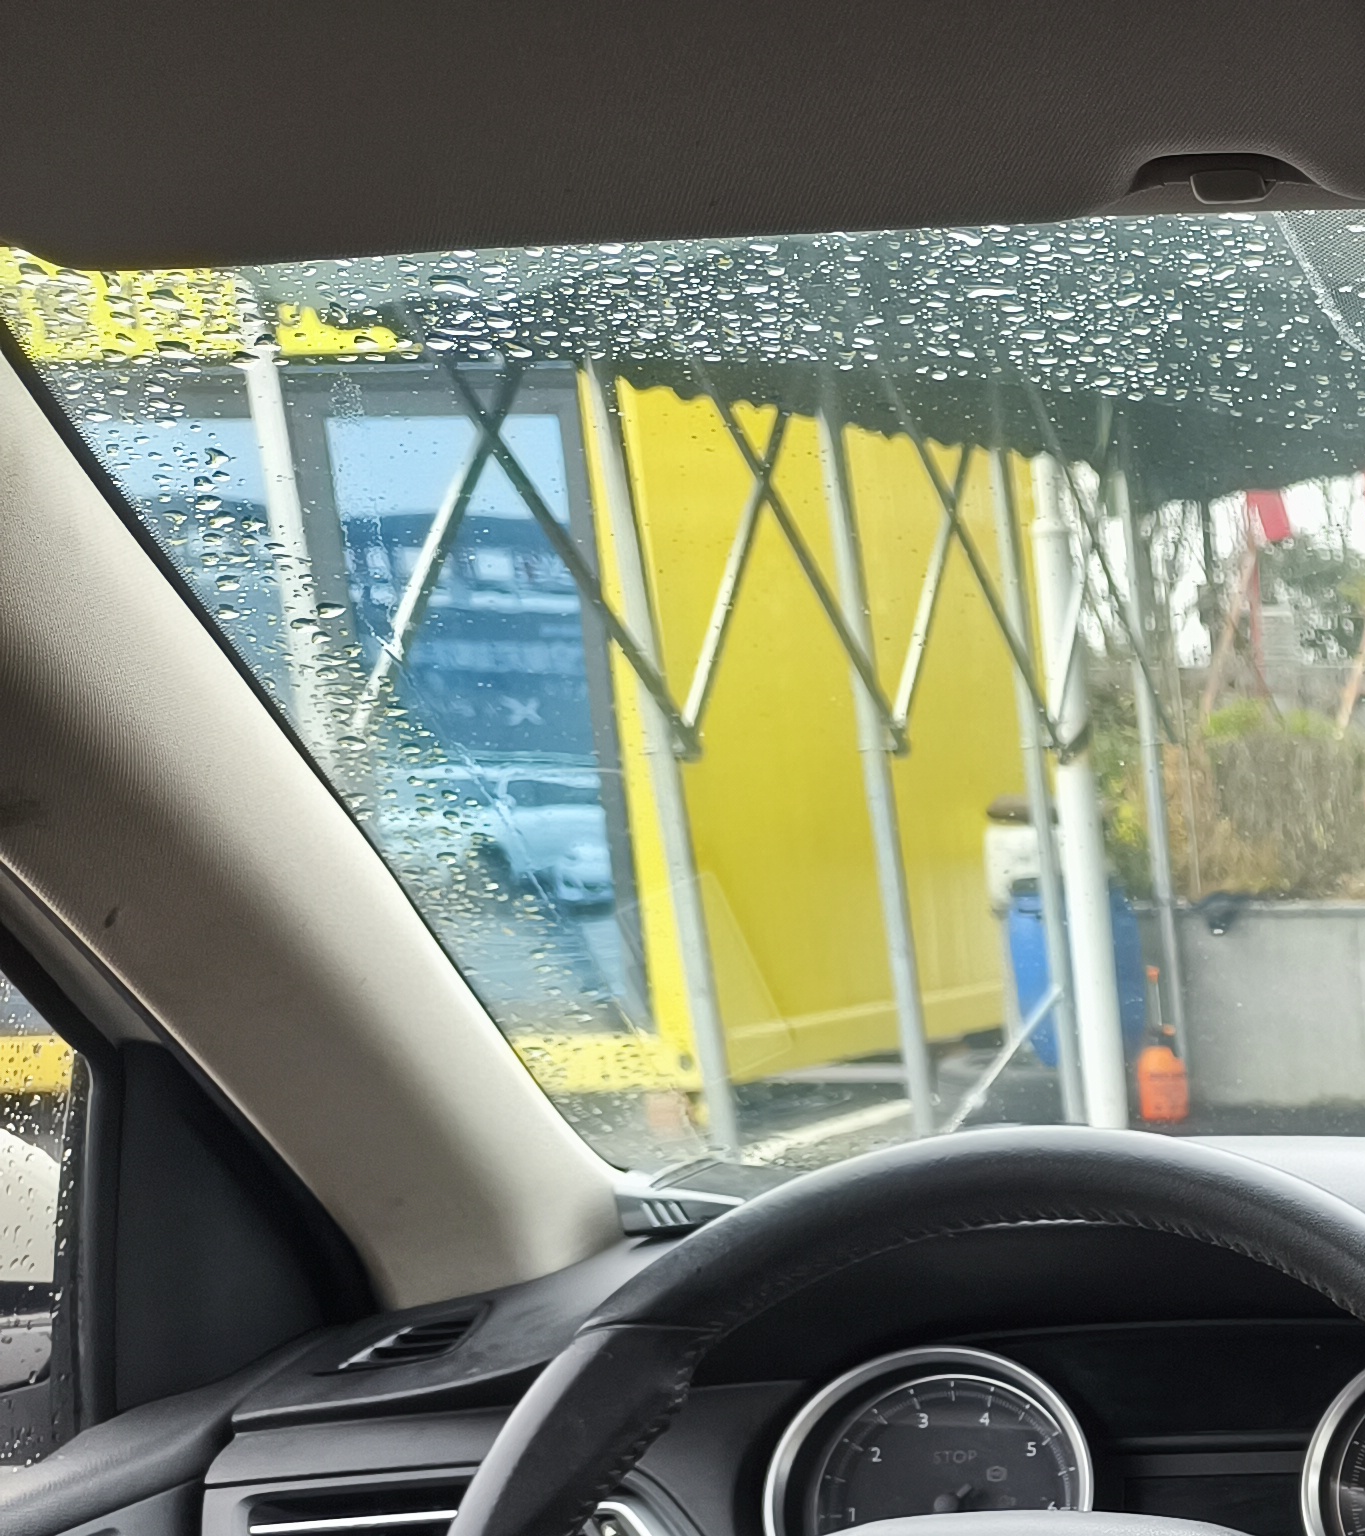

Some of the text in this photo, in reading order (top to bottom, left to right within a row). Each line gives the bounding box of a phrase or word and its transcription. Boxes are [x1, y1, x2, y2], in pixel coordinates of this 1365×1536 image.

[916, 1412, 929, 1428] 3
[978, 1412, 990, 1426] 4
[870, 1446, 882, 1462] 2
[1026, 1441, 1037, 1456] 5
[932, 1450, 977, 1464] STOP
[848, 1508, 856, 1521] 1
